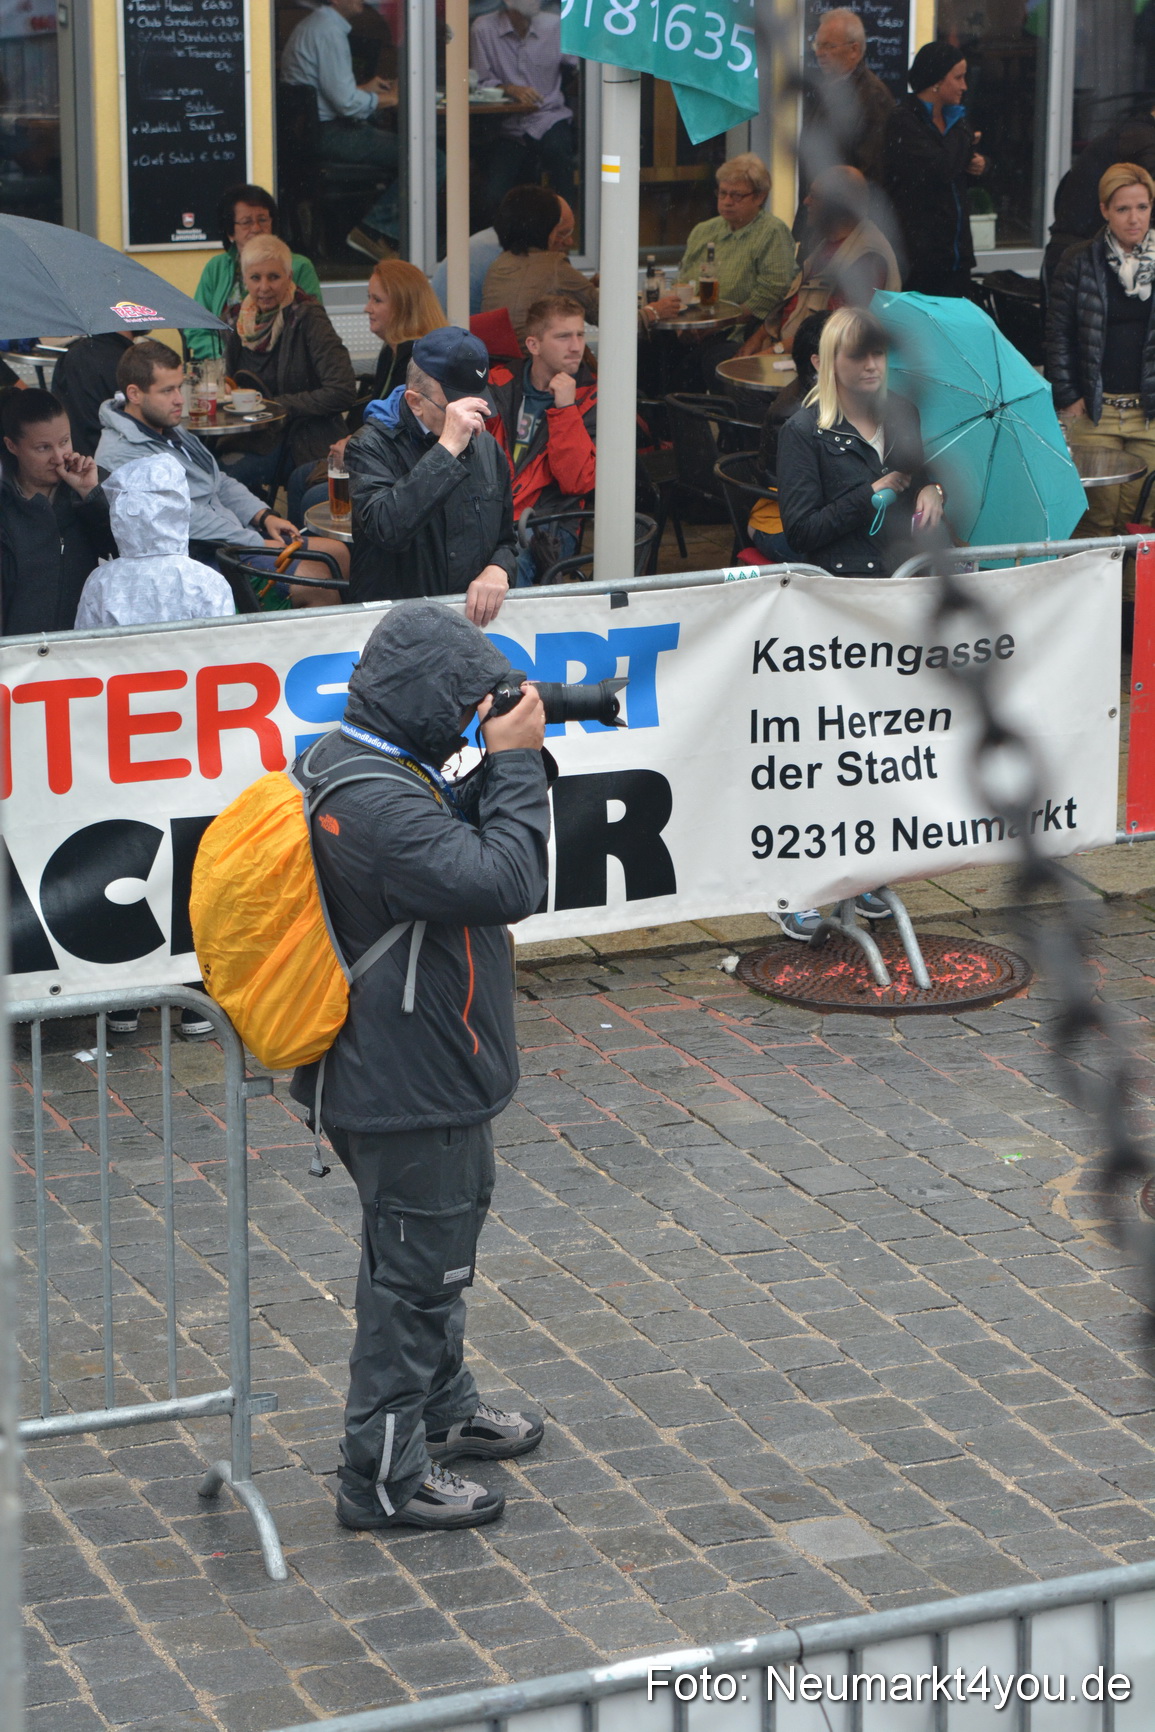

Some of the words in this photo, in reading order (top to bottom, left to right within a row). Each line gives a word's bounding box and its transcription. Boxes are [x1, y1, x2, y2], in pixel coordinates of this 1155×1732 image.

[752, 633, 1015, 676] Kastengasse
[750, 709, 800, 744] Im
[817, 704, 952, 741] Herzen
[381, 742, 401, 757] Berlin
[750, 755, 823, 790] der
[836, 745, 937, 787] Stadt
[750, 819, 876, 860] 92318
[892, 797, 1077, 852] Neumarkt
